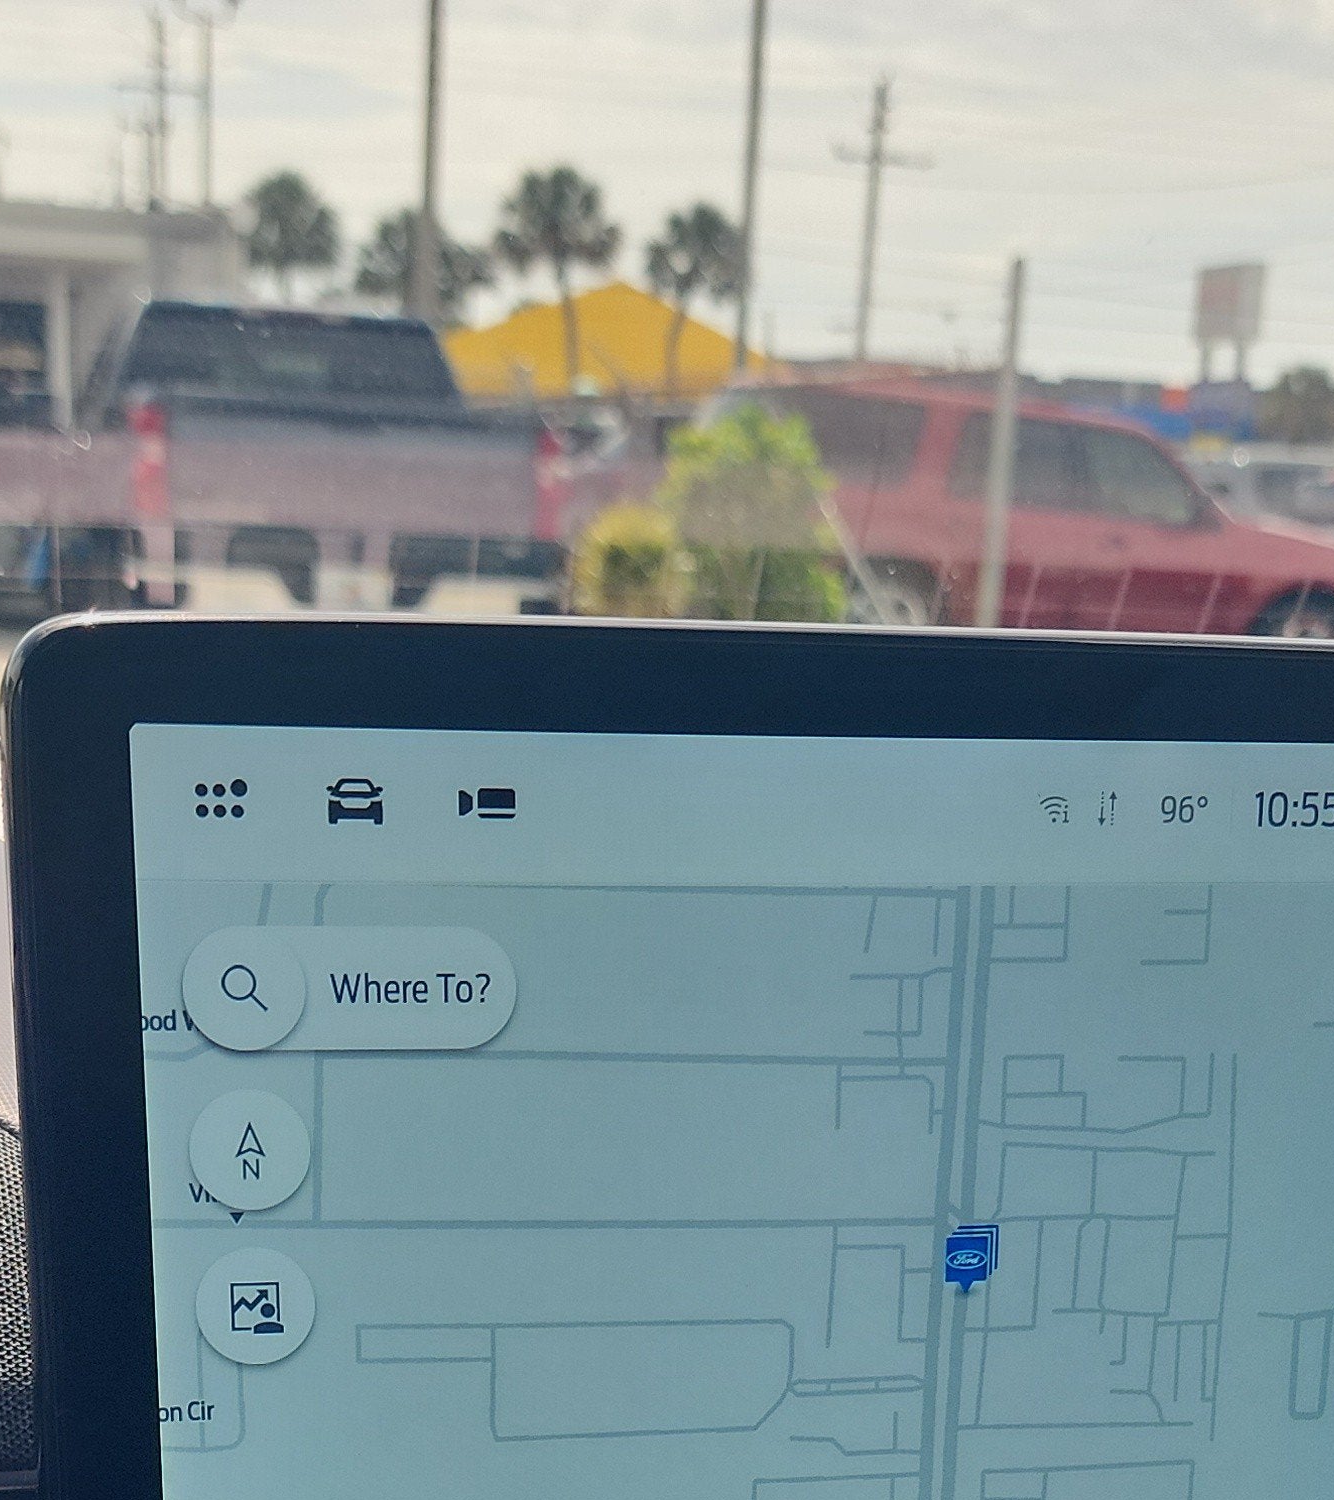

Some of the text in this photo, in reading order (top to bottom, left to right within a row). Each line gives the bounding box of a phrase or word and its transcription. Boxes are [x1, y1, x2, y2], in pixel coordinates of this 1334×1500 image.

[1161, 795, 1209, 824] 96°
[329, 972, 491, 1004] Where To?
[242, 1158, 260, 1180] N
[187, 1401, 215, 1421] Cir
